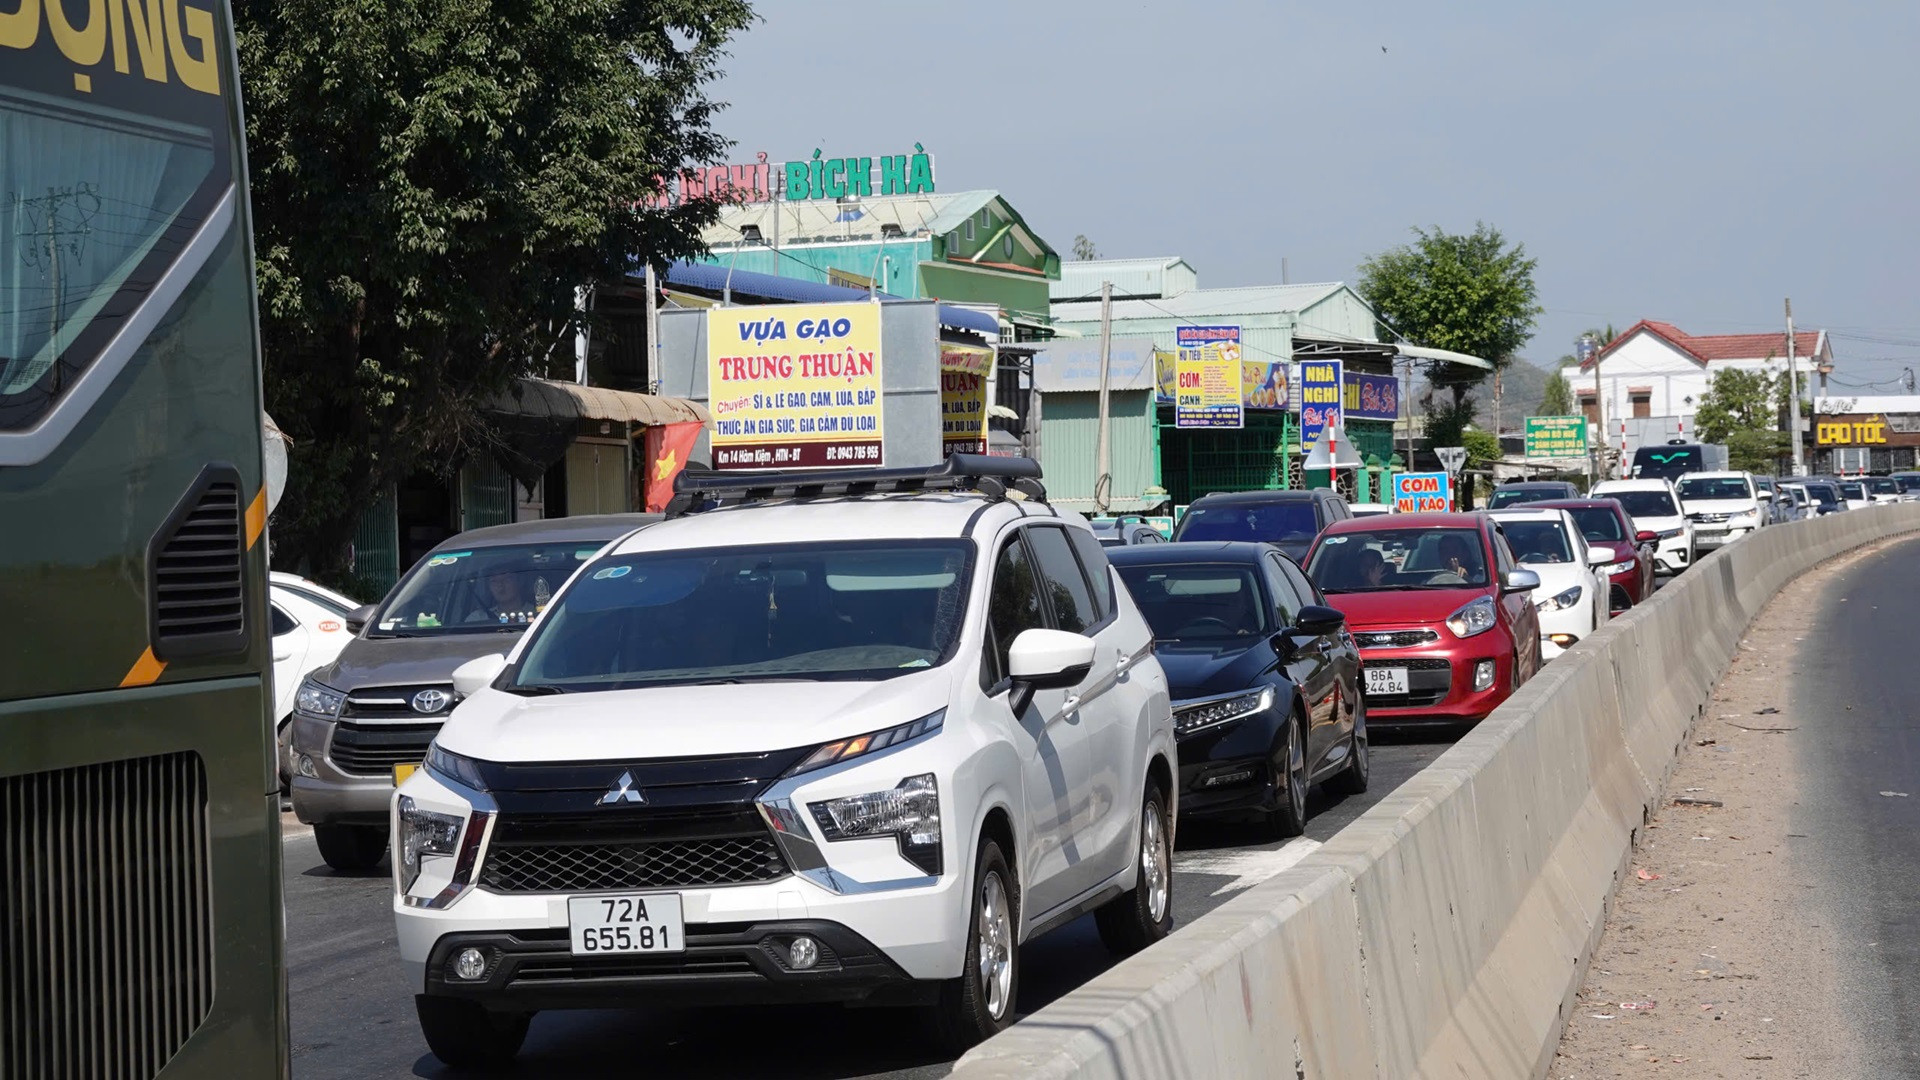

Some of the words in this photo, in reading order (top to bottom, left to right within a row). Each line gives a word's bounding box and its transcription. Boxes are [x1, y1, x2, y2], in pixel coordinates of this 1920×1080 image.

[785, 148, 872, 200] BÍCH
[881, 142, 935, 196] HÀ
[739, 317, 787, 347] VỰA
[796, 318, 851, 344] GẠO
[719, 355, 793, 381] TRUNG
[798, 346, 874, 384] THUẬN
[1305, 363, 1335, 382] NHÀ
[717, 396, 751, 413] Chuyên:
[766, 396, 772, 409] &
[1303, 383, 1339, 403] NGHỈ
[717, 418, 742, 436] THỨC
[759, 419, 774, 434] GIA
[777, 416, 797, 434] SÚC,
[800, 418, 816, 433] GIA
[818, 412, 838, 432] CẦM
[841, 412, 854, 431] ĐỦ
[857, 415, 876, 433] LOẠI
[1817, 422, 1851, 445] CAO
[1853, 413, 1888, 444] TỐC
[718, 450, 729, 464] Km
[730, 450, 738, 463] 14
[739, 449, 754, 463] Hàm
[837, 446, 853, 460] 0943
[854, 445, 866, 459] 785
[867, 445, 879, 459] 955
[1371, 670, 1393, 681] 86A
[601, 898, 650, 923] 72A
[583, 925, 669, 951] 655.81
